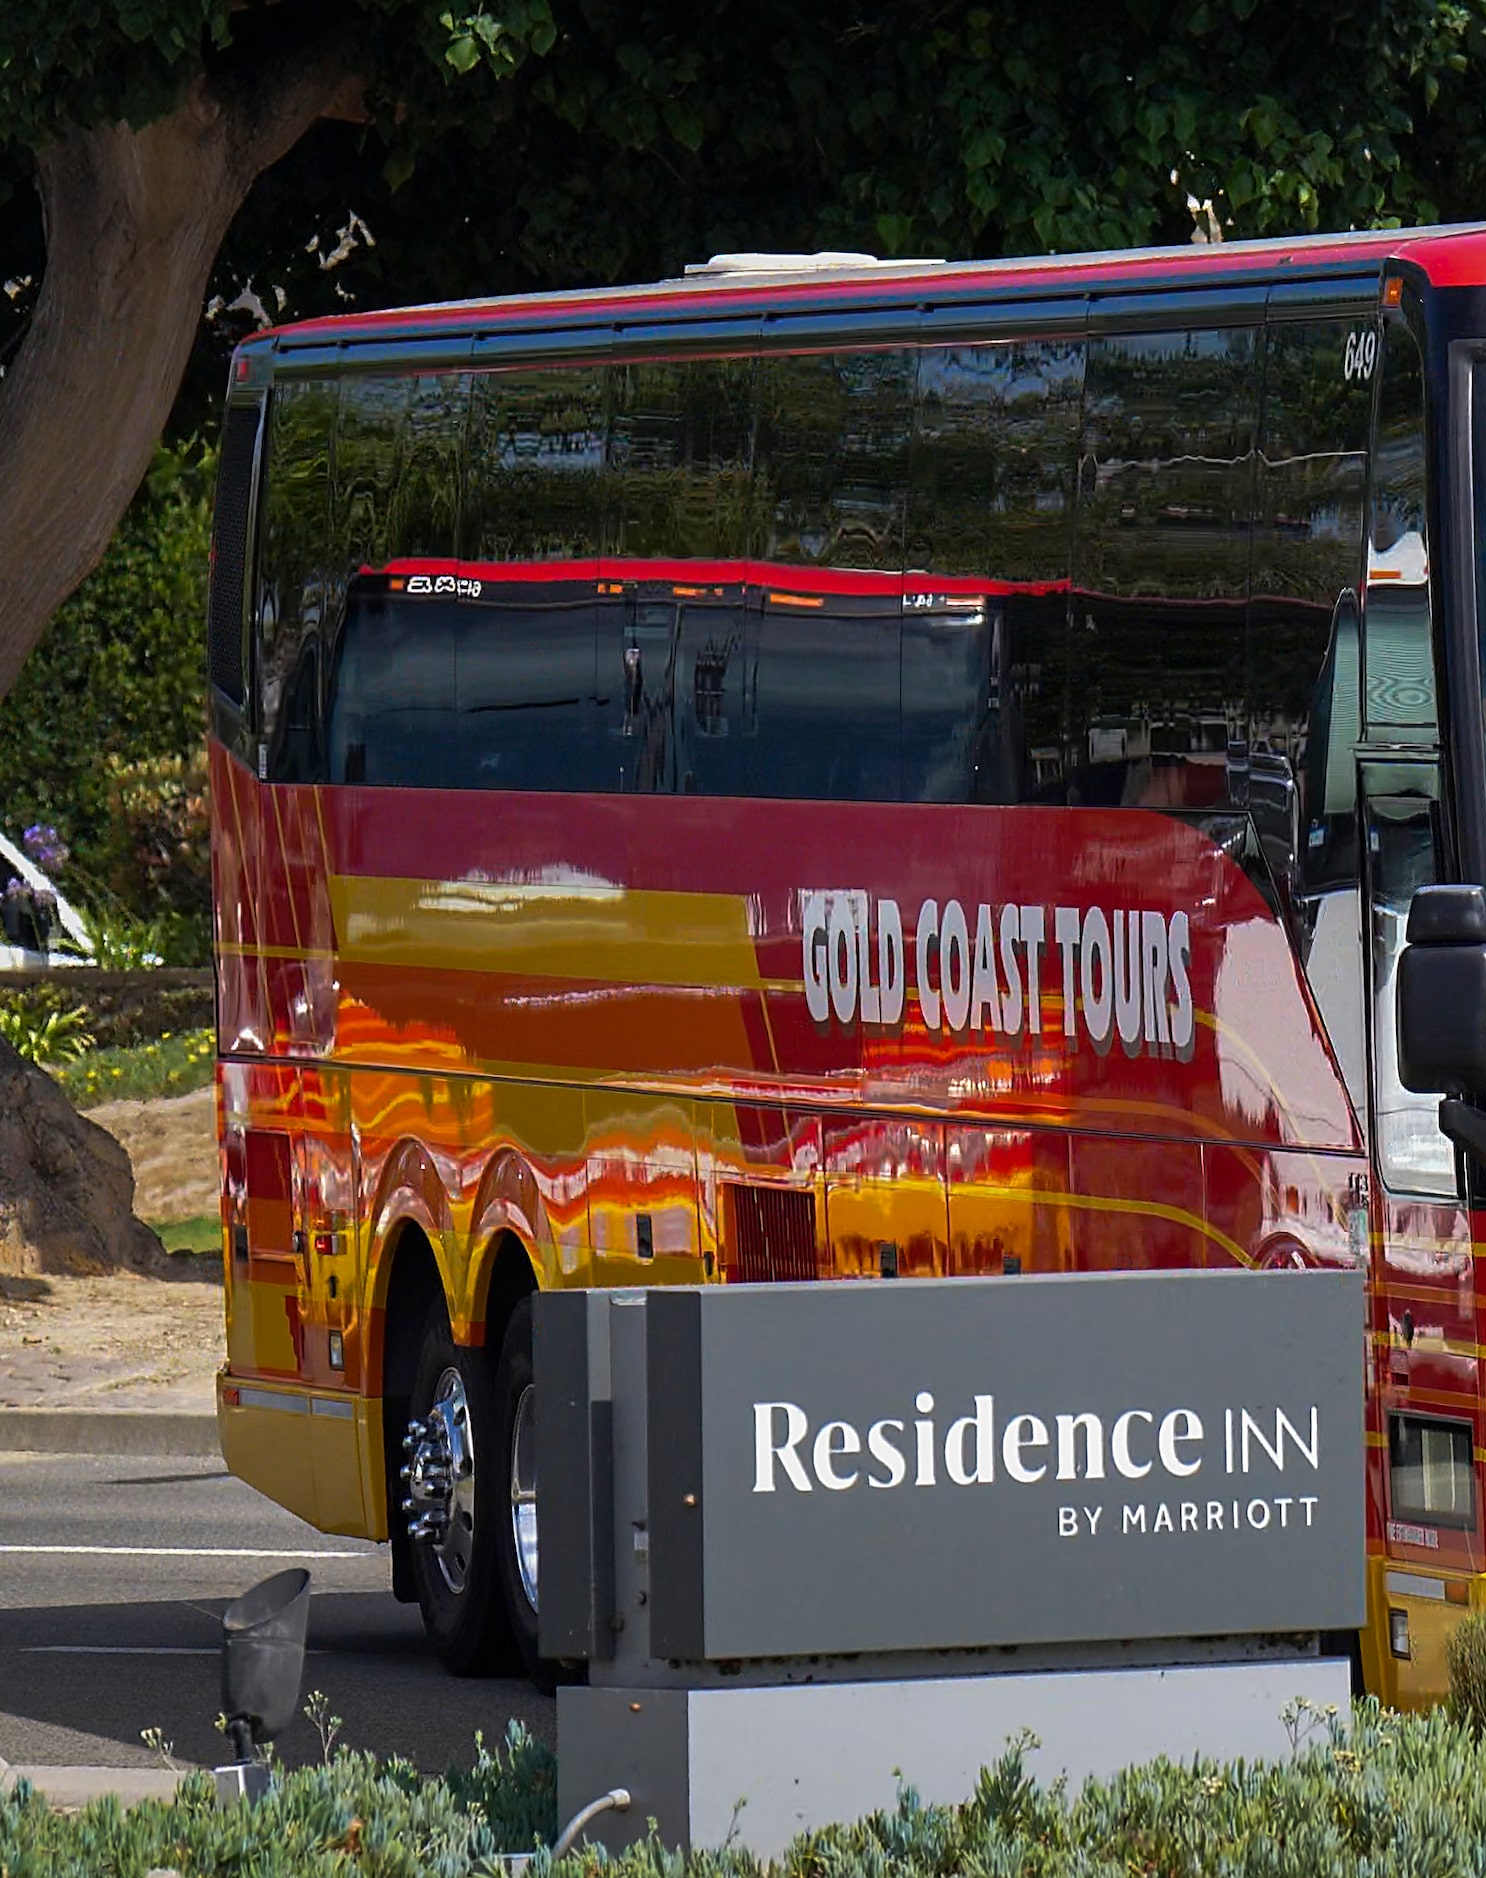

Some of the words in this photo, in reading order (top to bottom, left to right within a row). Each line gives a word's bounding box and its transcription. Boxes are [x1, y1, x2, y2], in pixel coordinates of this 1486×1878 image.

[1344, 331, 1376, 380] 649
[801, 896, 904, 1025] GOLD
[916, 898, 1046, 1036] COAST
[1055, 906, 1194, 1048] TOURS
[752, 1391, 1203, 1493] Residence
[1224, 1405, 1320, 1474] INN
[1058, 1505, 1104, 1537] BY
[1121, 1496, 1320, 1535] MARRIOTT
